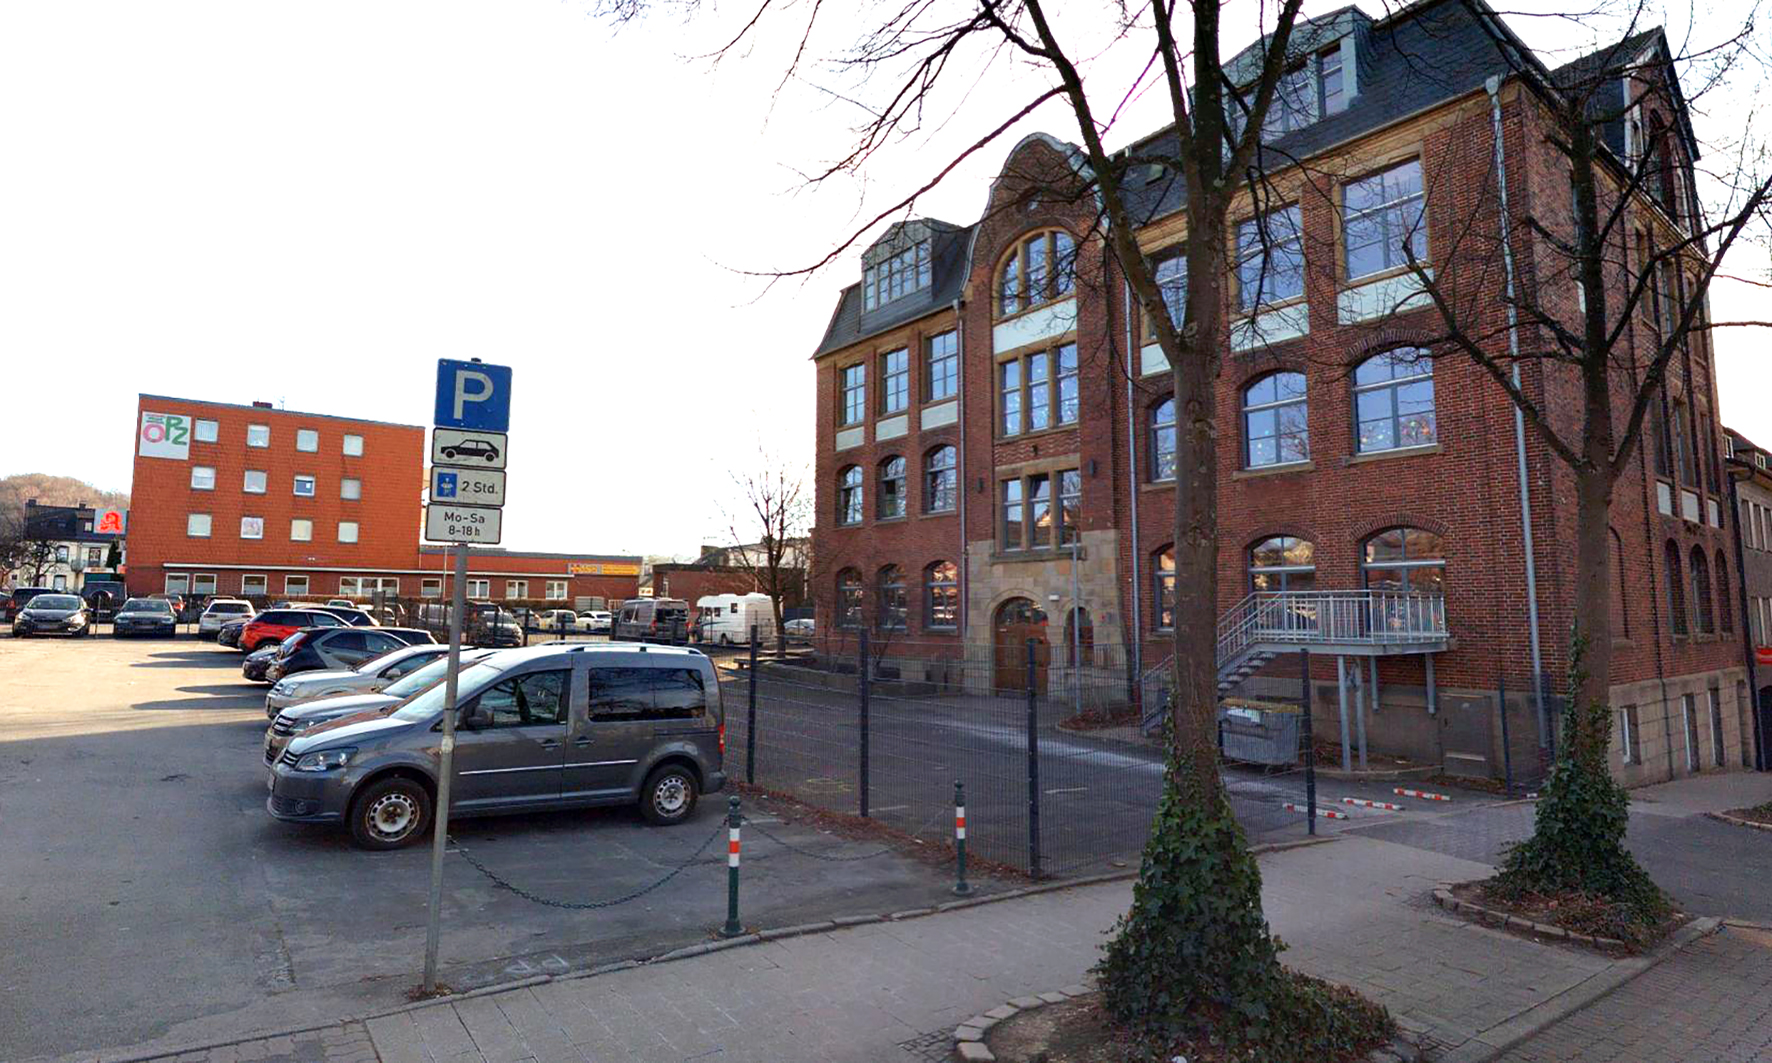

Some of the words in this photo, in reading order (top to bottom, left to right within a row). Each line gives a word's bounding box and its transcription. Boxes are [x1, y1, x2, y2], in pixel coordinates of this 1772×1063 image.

[454, 370, 494, 419] P
[461, 481, 470, 492] 2
[473, 482, 498, 494] Std.
